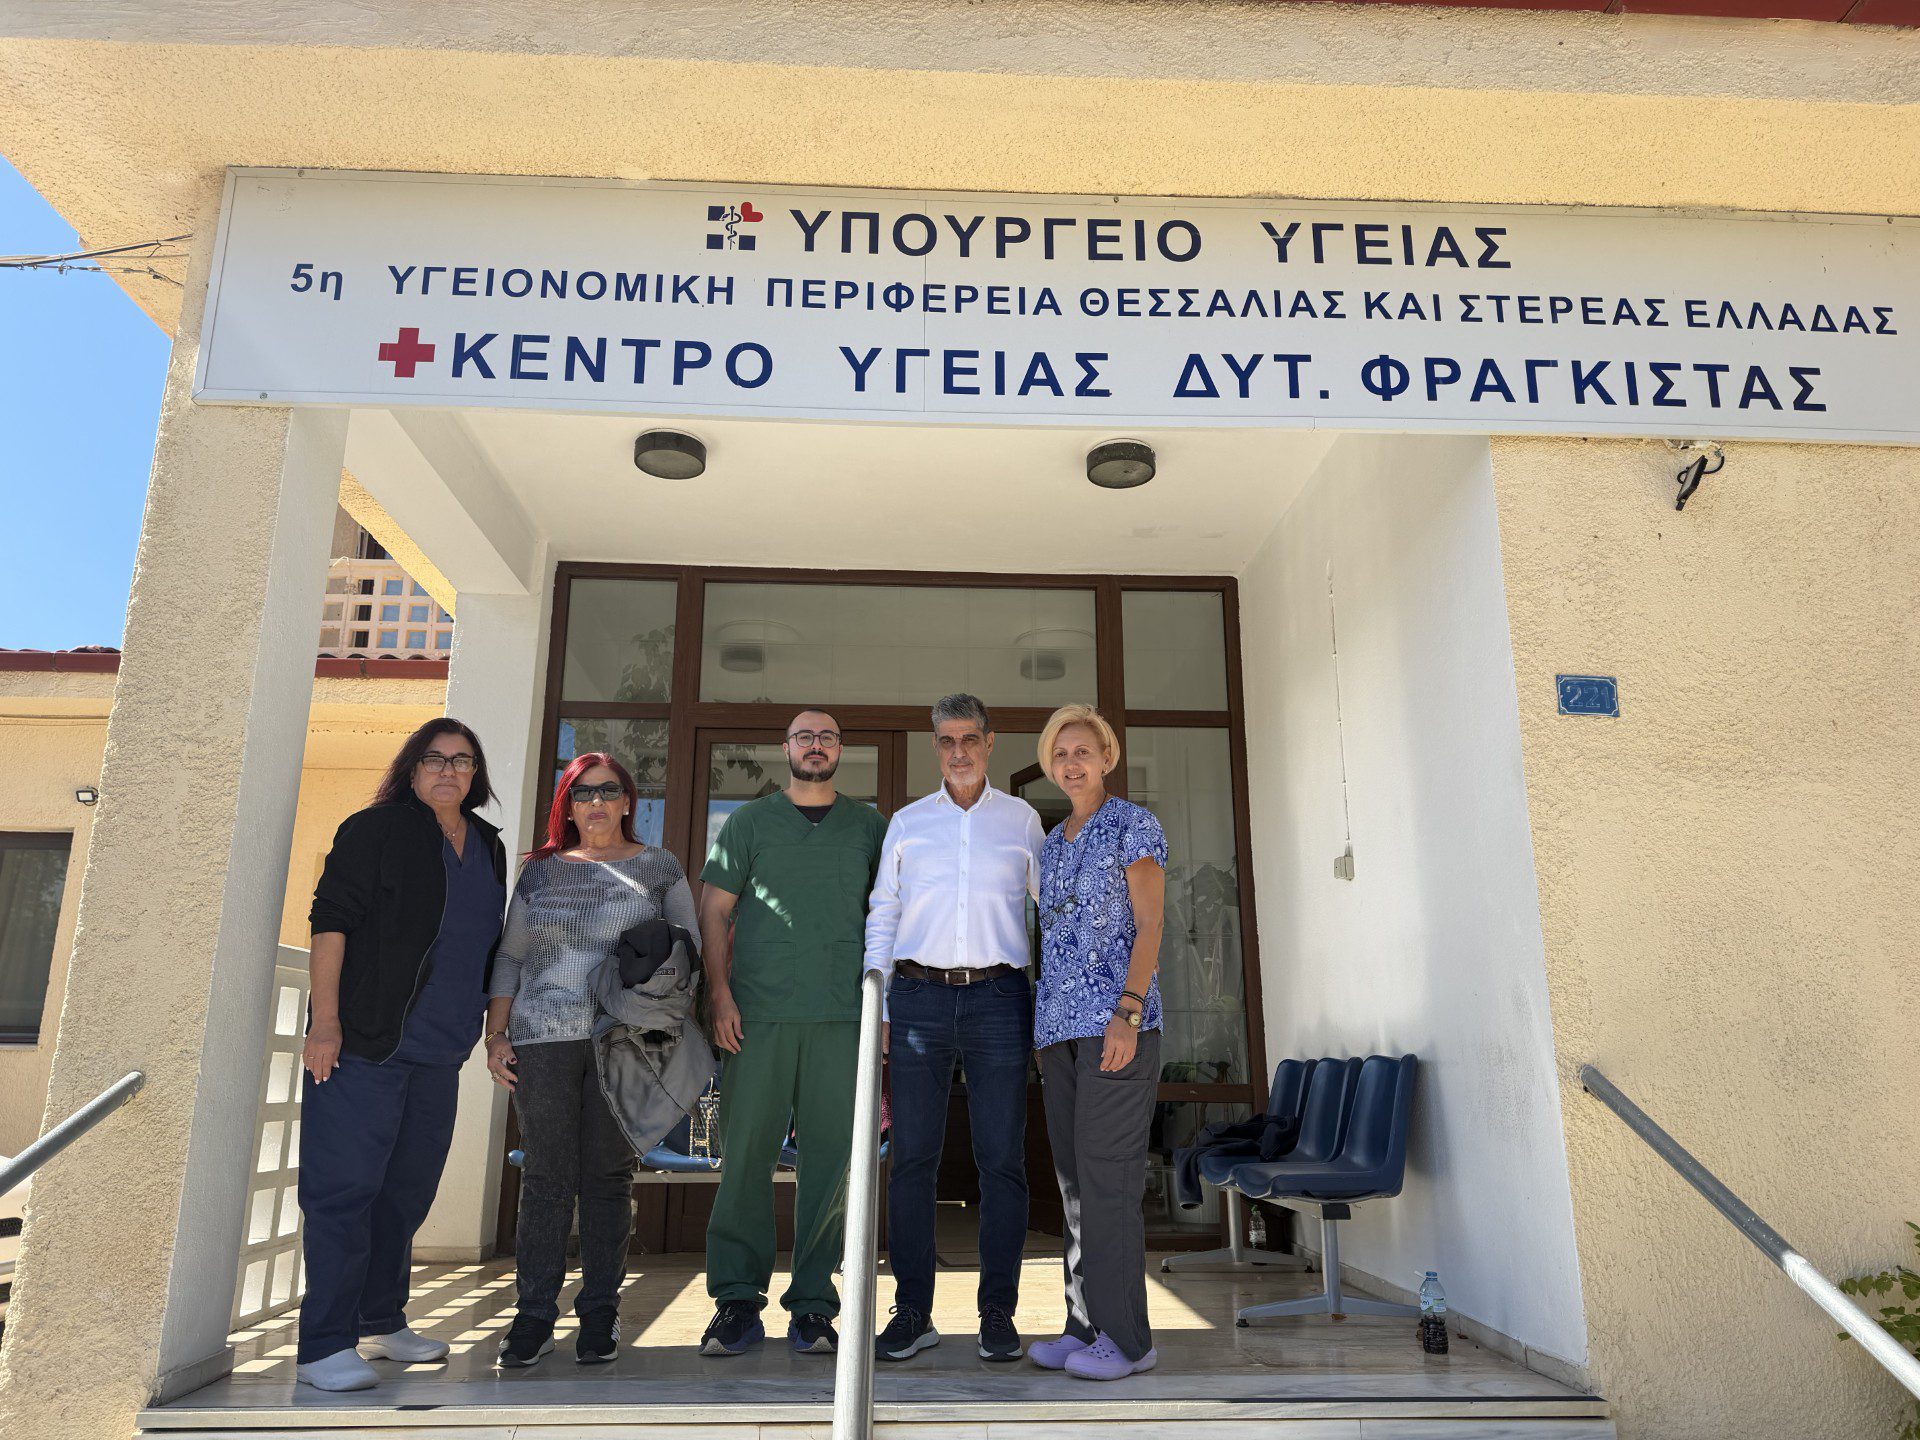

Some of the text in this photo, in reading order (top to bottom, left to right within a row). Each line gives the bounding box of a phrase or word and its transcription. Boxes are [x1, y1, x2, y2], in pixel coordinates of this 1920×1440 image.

[789, 209, 1512, 269] ΥΠΟΥΡΓΕΙΟ ΥΓΕΙΑΣ
[290, 263, 1898, 336] 5η ΥΓΕΙΟΝΟΜΙΚΗ ΠΕΡΙΦΕΡΕΙΑ ΘΕΣΣΑΛΙΑΣ ΚΑΙ ΣΤΕΡΕΑΣ ΕΛΛΑΔΑΣ
[451, 332, 1827, 412] ΚΕΝΤΡΟ ΥΓΕΙΑΣ ΔΥΤ. ΦΡΑΓΚΙΣΤΑΣ
[1565, 684, 1611, 709] 221
